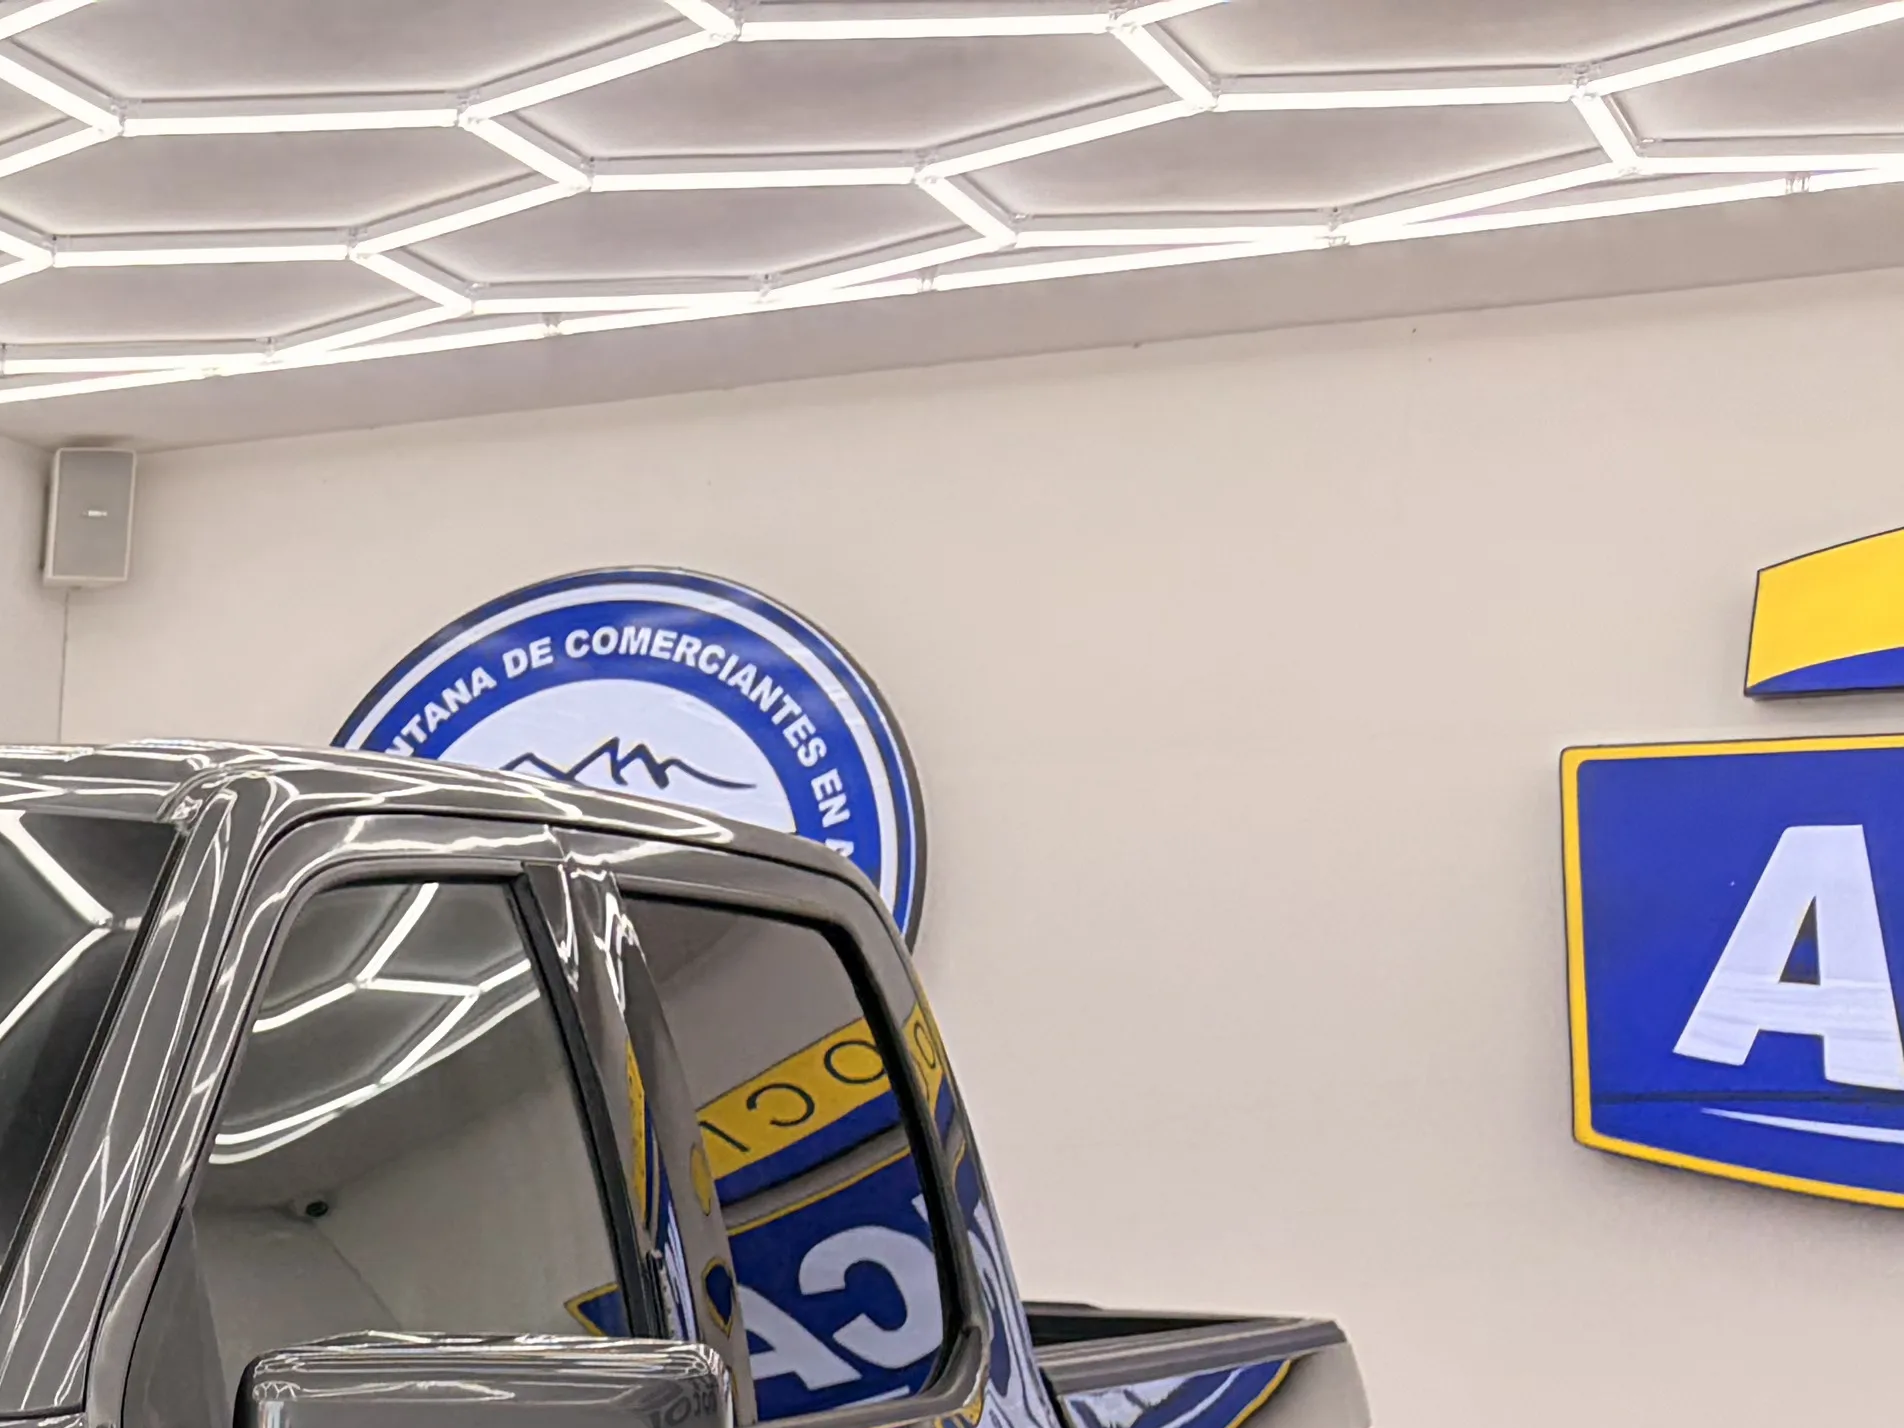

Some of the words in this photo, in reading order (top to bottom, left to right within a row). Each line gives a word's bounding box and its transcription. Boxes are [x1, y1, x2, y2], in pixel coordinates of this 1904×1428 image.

[503, 636, 554, 680] DE
[563, 625, 827, 768] COMERCIANTES
[810, 768, 851, 828] EN
